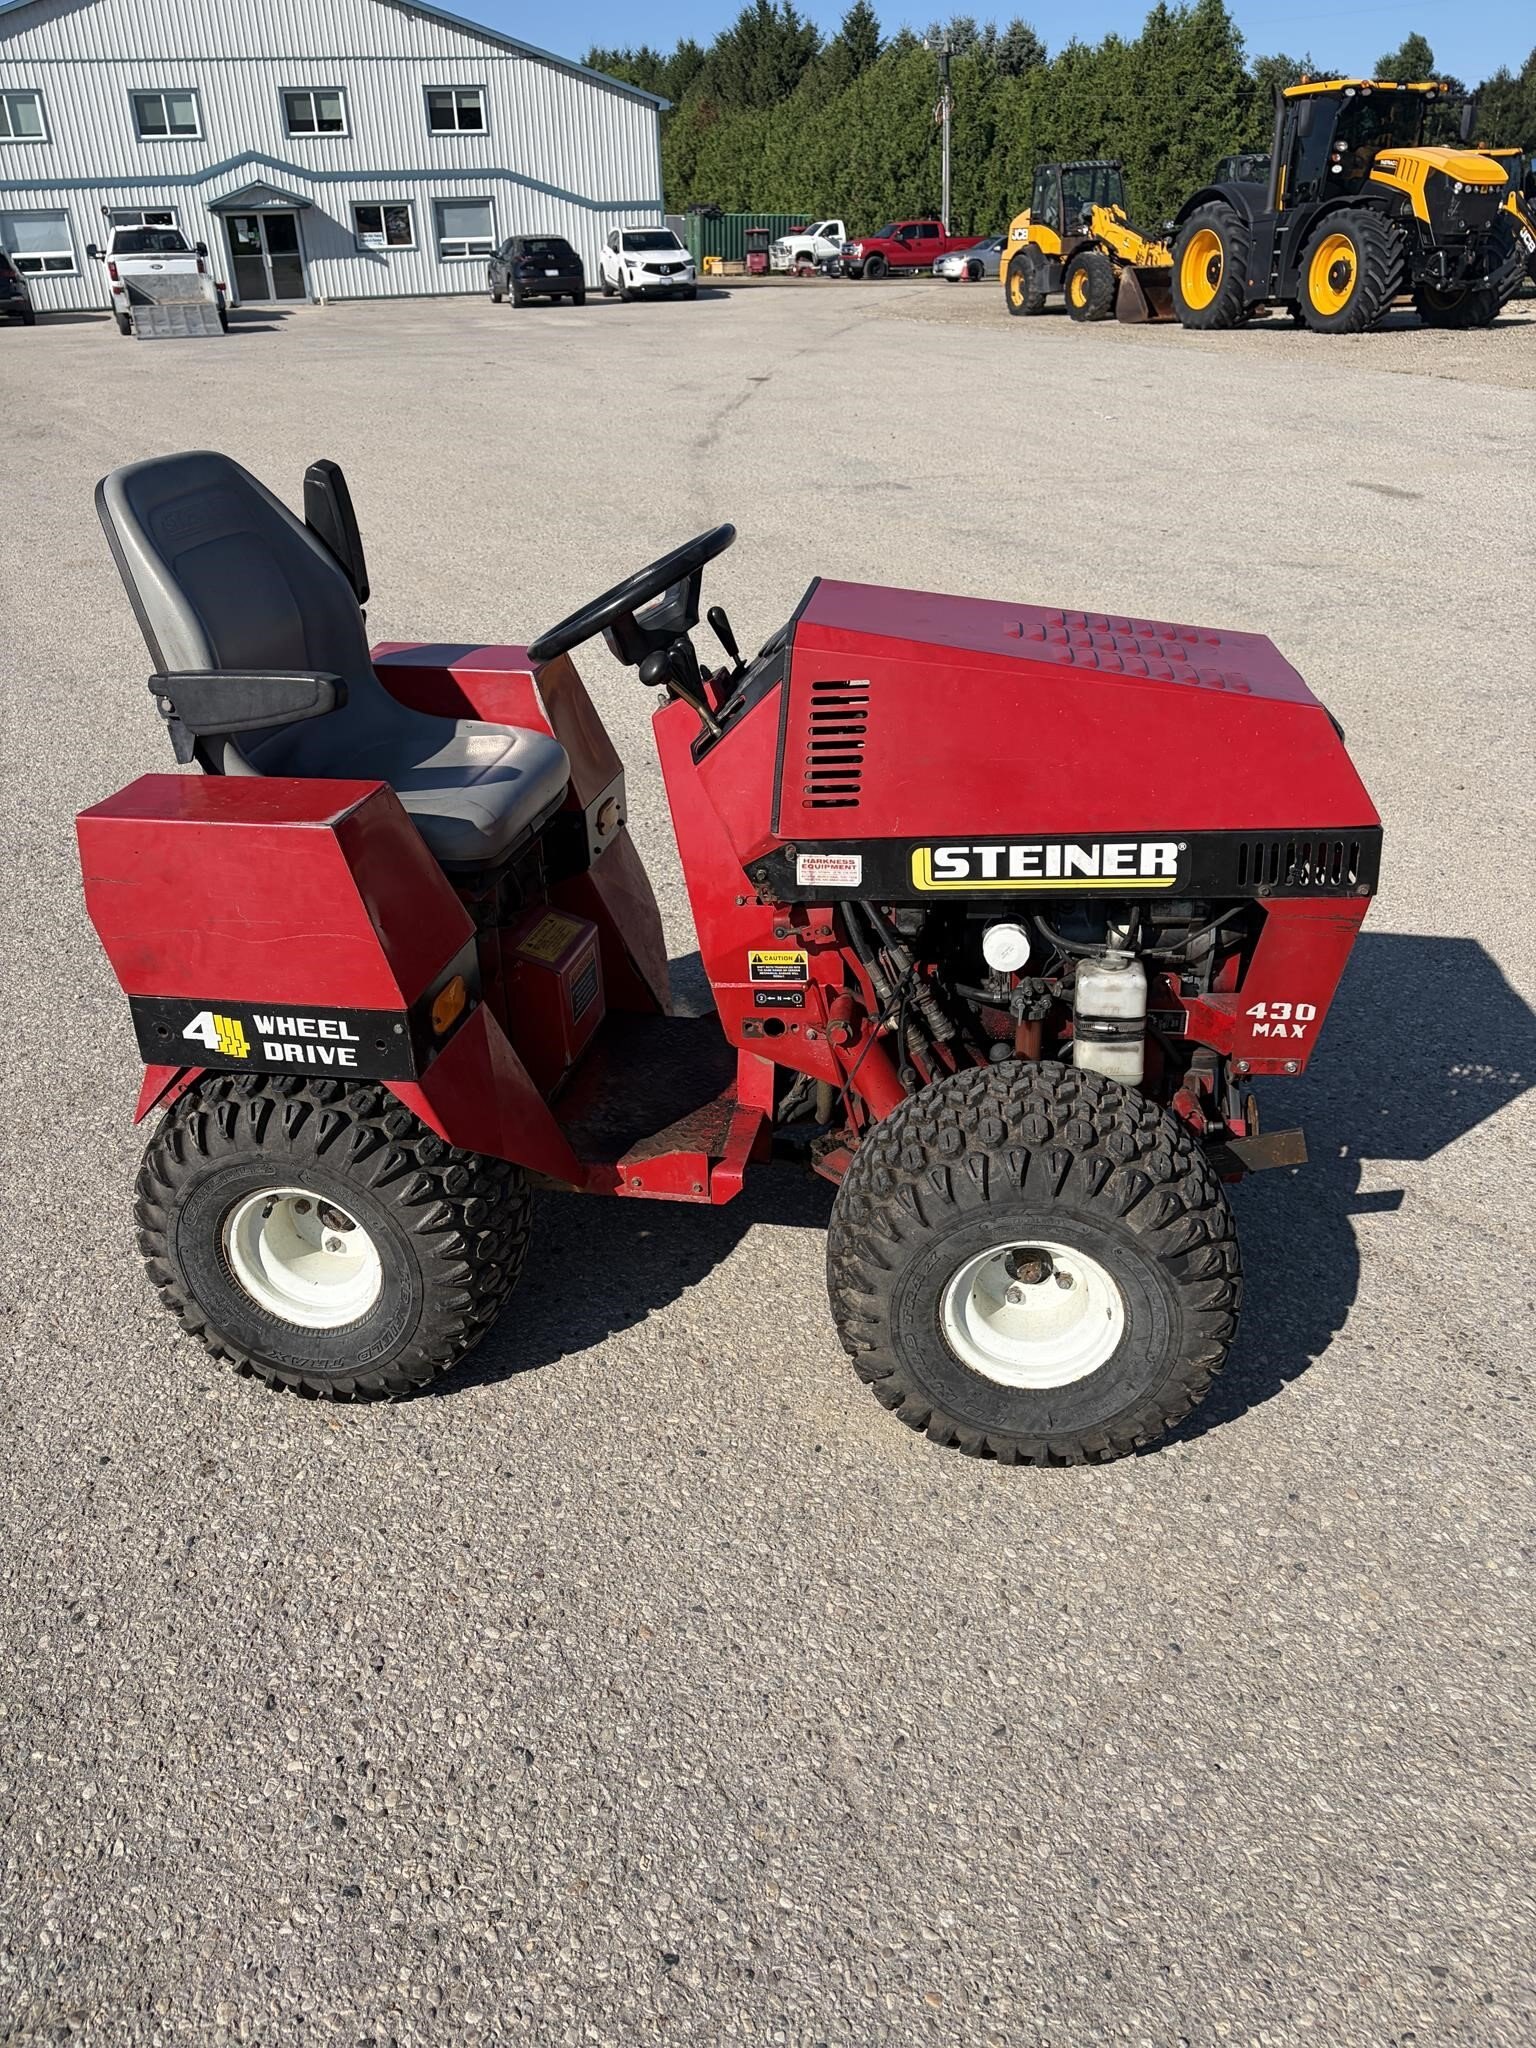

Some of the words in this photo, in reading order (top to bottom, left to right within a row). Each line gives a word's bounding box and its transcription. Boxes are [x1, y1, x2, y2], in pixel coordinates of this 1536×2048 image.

[1519, 226, 1536, 253] JCB
[934, 842, 1178, 879] STEINER
[1245, 1002, 1317, 1021] 430
[182, 1010, 224, 1052] 4
[252, 1014, 360, 1041] WHEEL
[1252, 1022, 1308, 1039] MAX
[263, 1041, 358, 1067] DRIVE
[357, 1306, 406, 1363] FIELD
[266, 1350, 345, 1369] TRAX
